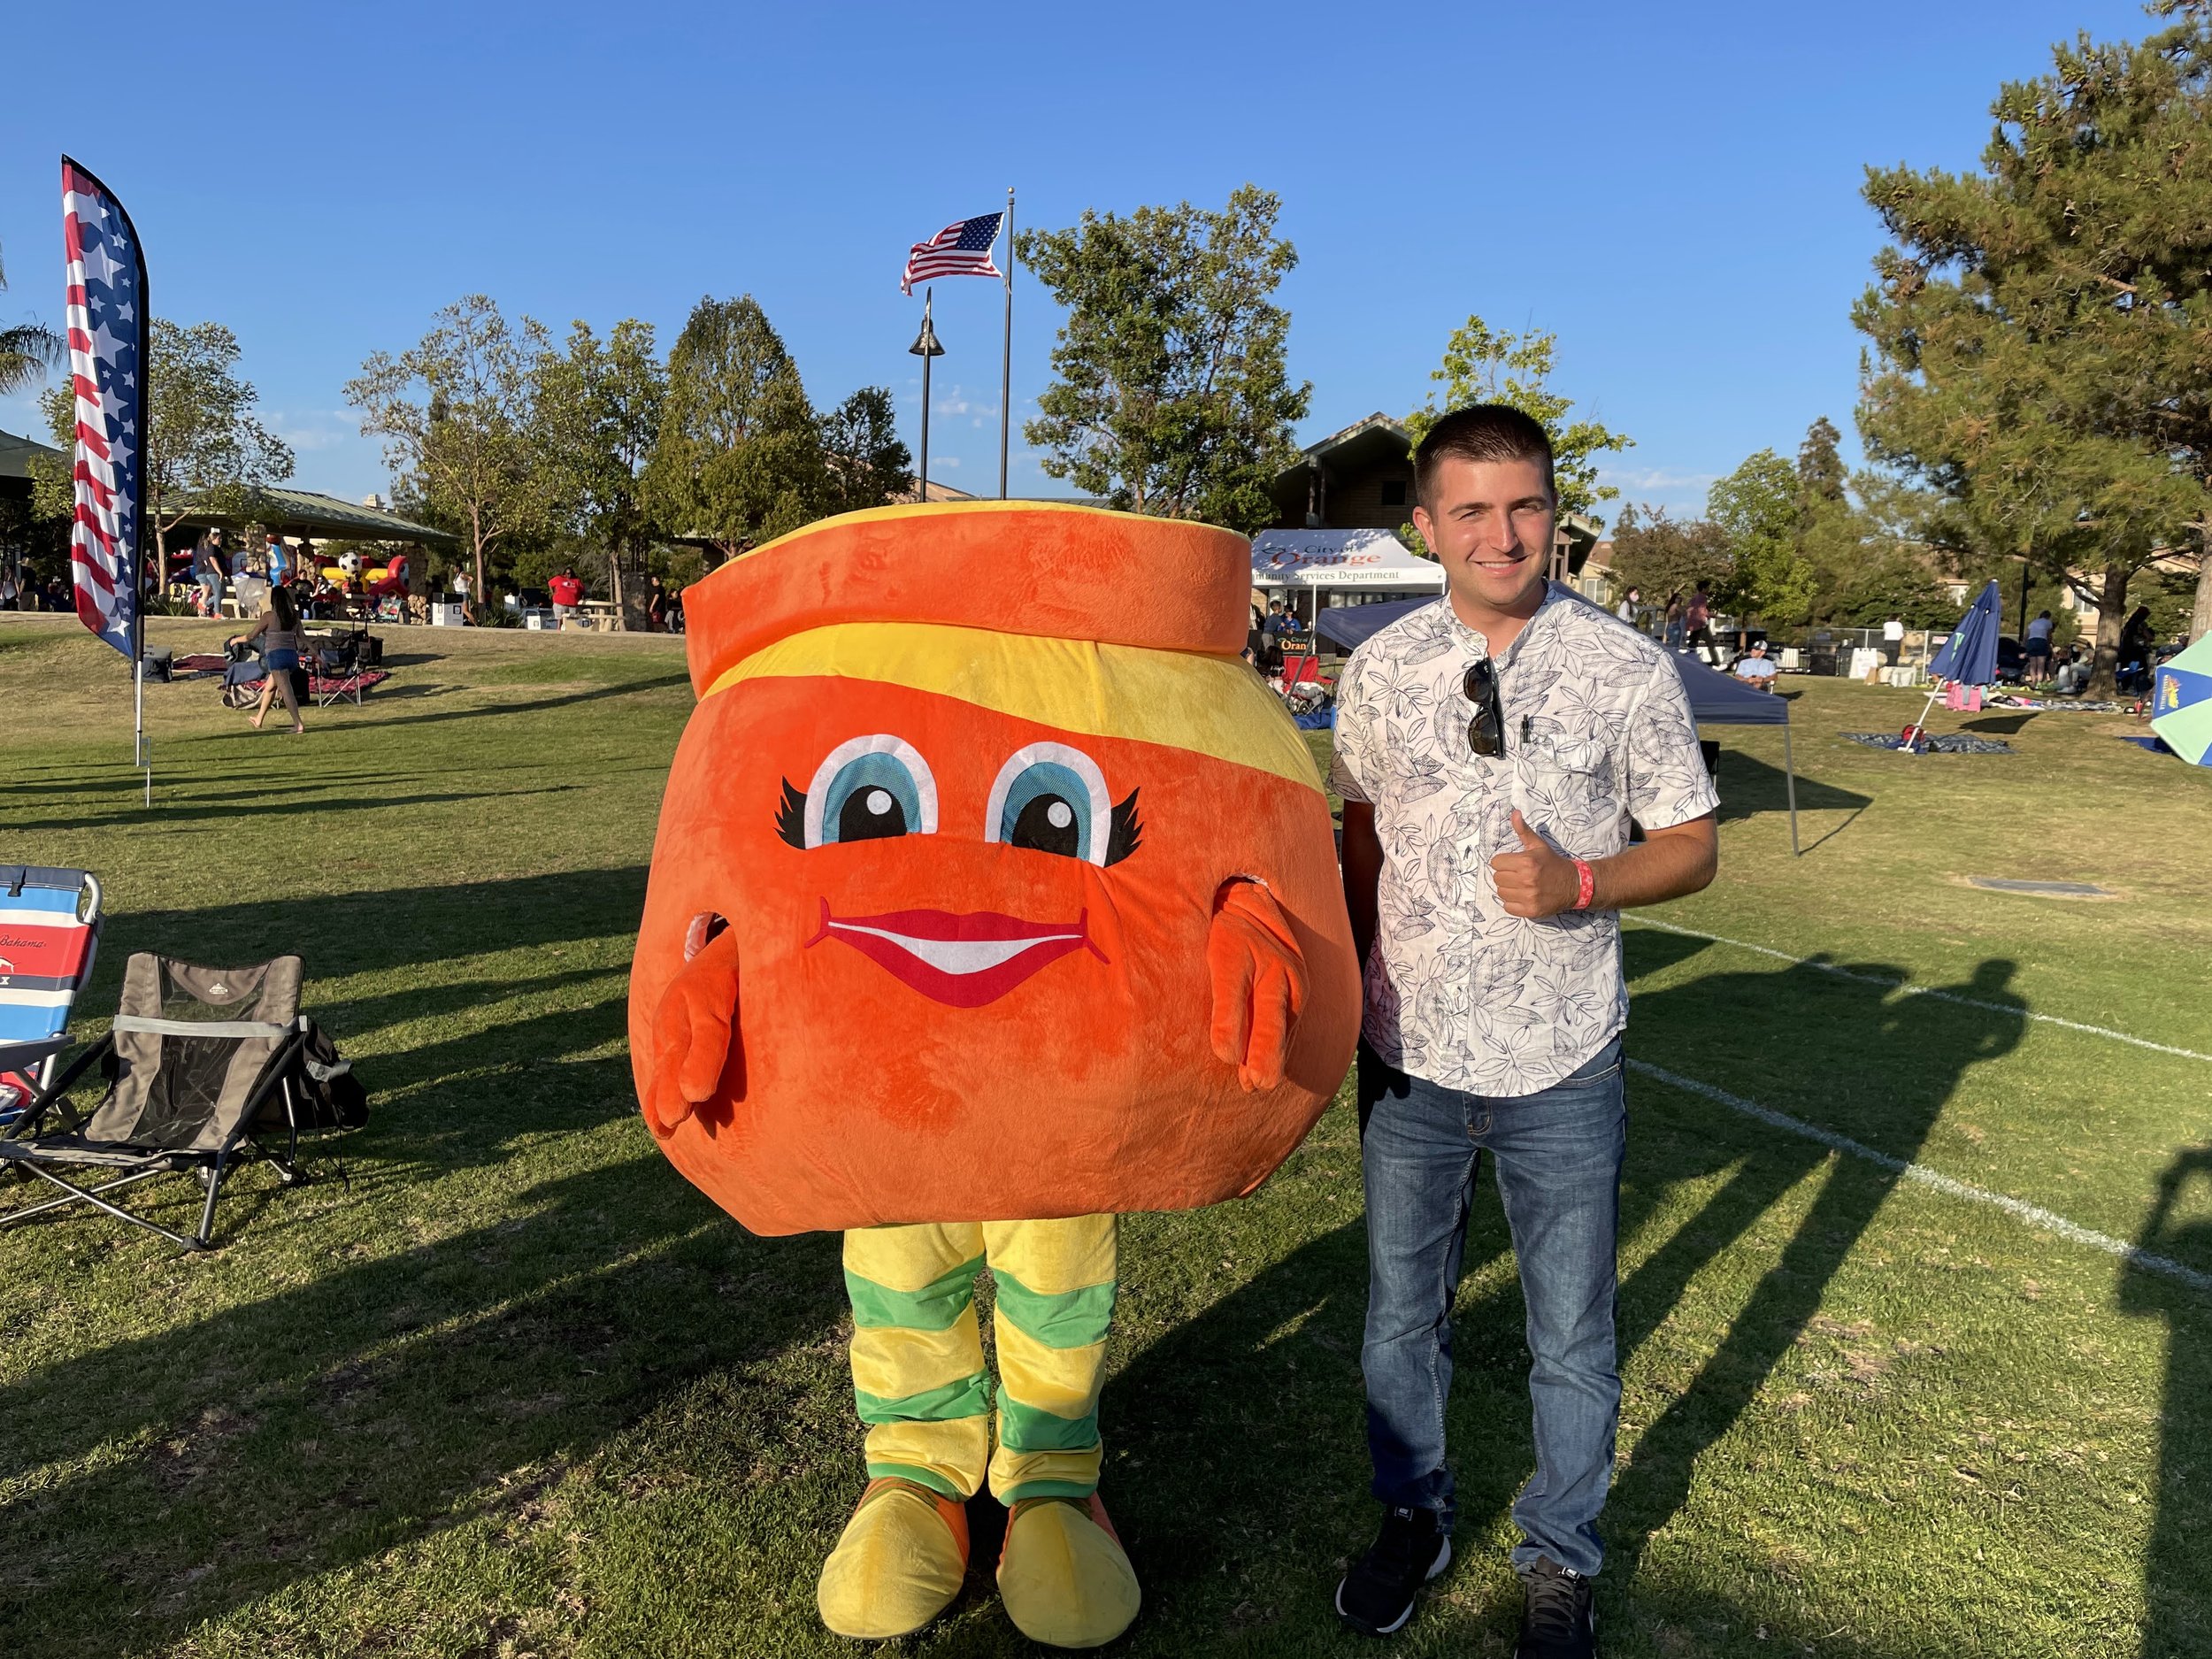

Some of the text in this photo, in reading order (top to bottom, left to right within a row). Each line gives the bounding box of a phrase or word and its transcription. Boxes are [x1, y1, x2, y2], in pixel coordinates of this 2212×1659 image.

[1304, 544, 1354, 554] City of
[1271, 551, 1381, 566] Orange
[1294, 571, 1335, 580] Services
[1339, 571, 1399, 581] Department
[1281, 640, 1317, 650] Oran
[0, 934, 44, 948] Bahama
